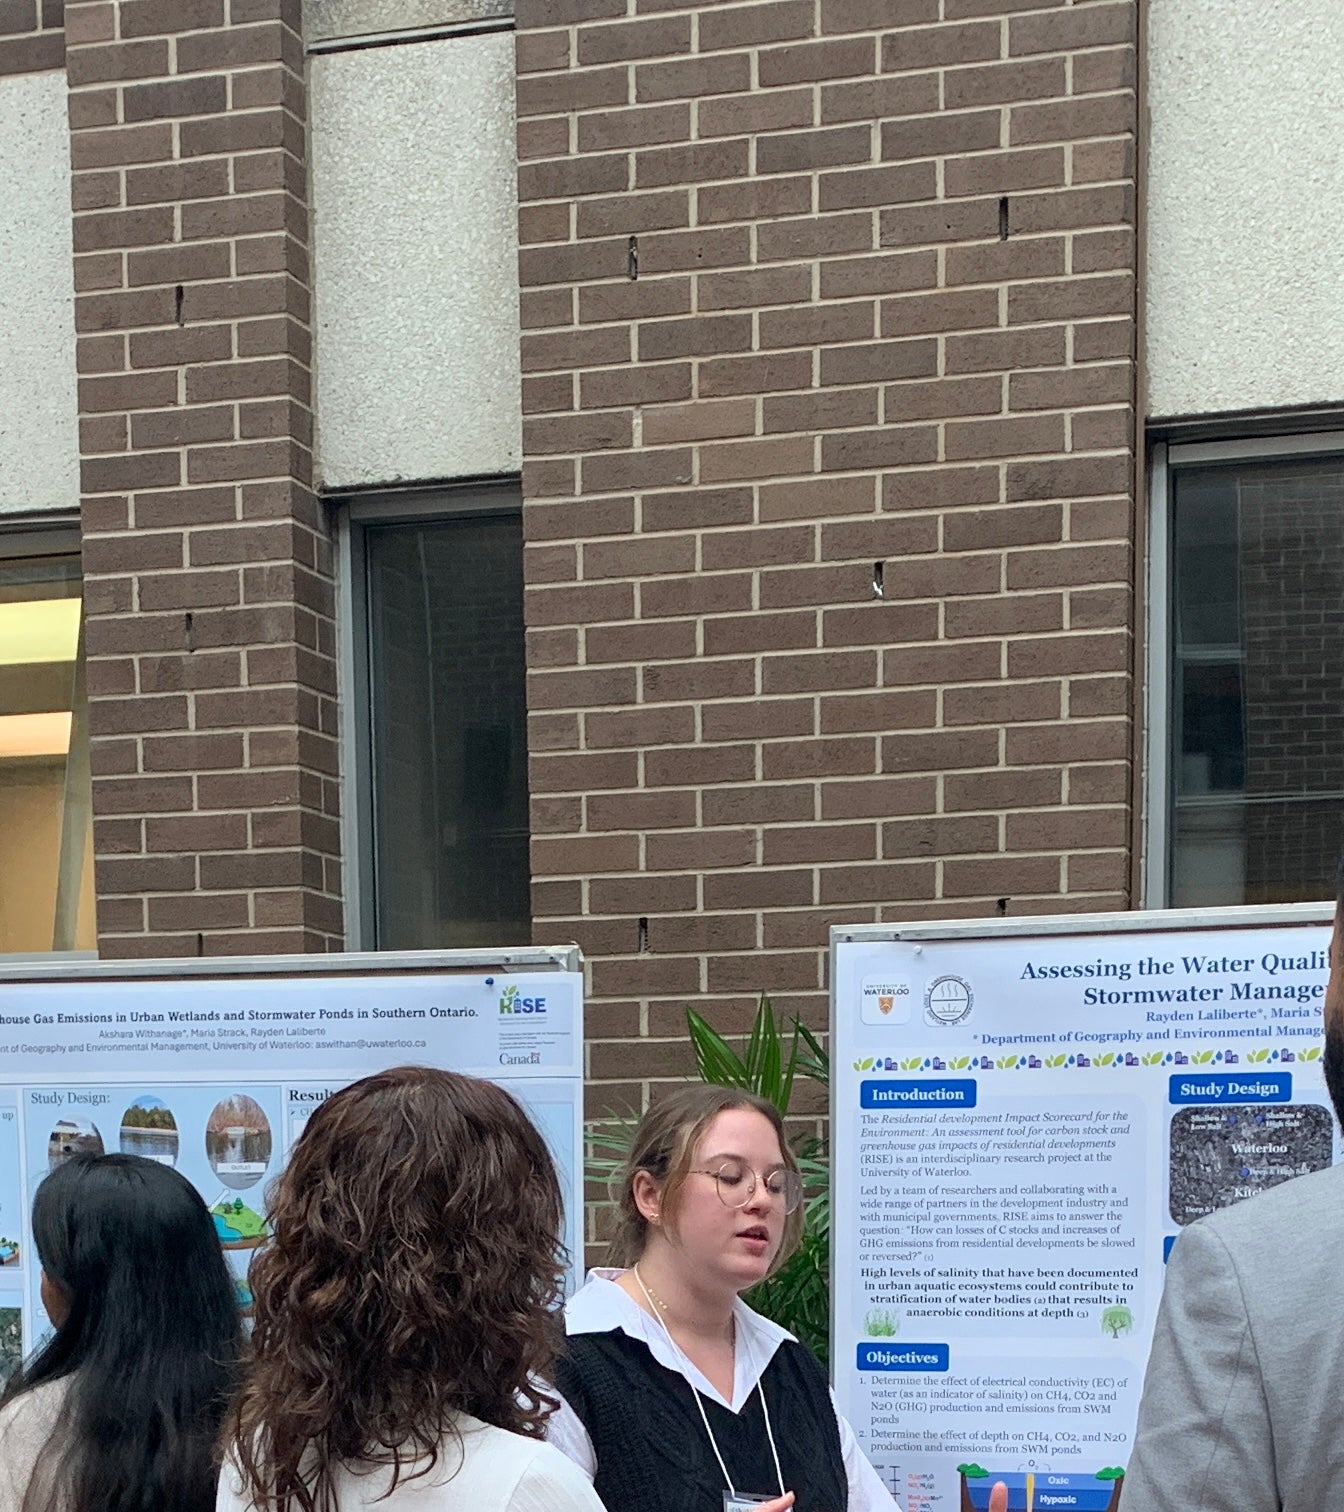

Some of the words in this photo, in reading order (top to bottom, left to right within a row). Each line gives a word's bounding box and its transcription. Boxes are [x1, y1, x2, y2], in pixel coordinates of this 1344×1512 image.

[1020, 958, 1132, 984] Assessing
[1138, 957, 1175, 976] the
[1181, 955, 1255, 975] Water
[1083, 983, 1224, 1005] Stormwater
[1230, 981, 1330, 1006] Manage
[499, 997, 547, 1014] RISE
[33, 1012, 54, 1024] Gas
[56, 1011, 113, 1024] Emissions
[115, 1011, 127, 1023] in
[129, 1011, 165, 1023] Urban
[167, 1010, 221, 1022] Wetlands
[223, 1010, 245, 1022] and
[247, 1009, 316, 1021] Stormwater
[318, 1008, 354, 1020] Ponds
[356, 1008, 369, 1020] in
[371, 1007, 426, 1019] Southern
[428, 1006, 480, 1019] Ontario.
[1145, 1010, 1194, 1025] Rayden
[1270, 1006, 1308, 1019] Maria
[98, 1028, 134, 1039] Akshara
[190, 1027, 216, 1038] Maria
[216, 1027, 248, 1039] Strack,
[250, 1026, 284, 1039] Rayden
[285, 1026, 327, 1036] Laliberte
[981, 1030, 1056, 1046] Department
[1058, 1030, 1073, 1042] of
[1073, 1029, 1143, 1044] Geography
[1145, 1028, 1170, 1040] and
[1173, 1026, 1272, 1040] Environmental
[10, 1043, 19, 1053] of
[20, 1042, 66, 1055] Geography
[67, 1042, 85, 1053] and
[85, 1041, 149, 1052] Environmental
[150, 1041, 208, 1054] Management,
[212, 1040, 257, 1053] University
[258, 1040, 268, 1050] of
[269, 1039, 311, 1050] Waterloo:
[315, 1038, 427, 1051] aswithan@uwaterloo.ca
[499, 1052, 541, 1066] Canada
[872, 1089, 965, 1101] Introduction
[1180, 1082, 1225, 1098] Study
[1227, 1081, 1280, 1097] Design
[30, 1092, 66, 1106] Study
[67, 1091, 111, 1106] Design:
[1, 1113, 15, 1122] up
[1231, 1143, 1288, 1154] Waterloo
[860, 1267, 887, 1280] High
[889, 1267, 921, 1278] levels
[922, 1267, 936, 1278] of
[936, 1267, 979, 1280] salinity
[981, 1267, 1005, 1278] that
[1007, 1267, 1035, 1278] have
[1036, 1267, 1065, 1278] been
[1066, 1267, 1139, 1278] documented
[864, 1280, 875, 1291] in
[877, 1280, 912, 1291] urban
[913, 1280, 956, 1293] aquatic
[957, 1280, 1023, 1293] ecosystems
[1024, 1281, 1057, 1291] could
[1058, 1281, 1120, 1291] contribute
[1121, 1281, 1135, 1291] to
[906, 1307, 963, 1317] anaerobic
[963, 1307, 1025, 1317] conditions
[1026, 1307, 1039, 1317] at
[1040, 1307, 1076, 1320] depth
[866, 1351, 939, 1366] Objectives
[871, 1375, 922, 1386] Determine
[923, 1375, 939, 1386] the
[940, 1375, 968, 1386] effect
[969, 1376, 980, 1386] of
[981, 1376, 1027, 1387] electrical
[1028, 1376, 1089, 1389] conductivity
[1091, 1377, 1115, 1390] (EC)
[1116, 1377, 1128, 1388] of
[1047, 1476, 1069, 1485] Oxic
[1039, 1495, 1077, 1505] Hypoxic
